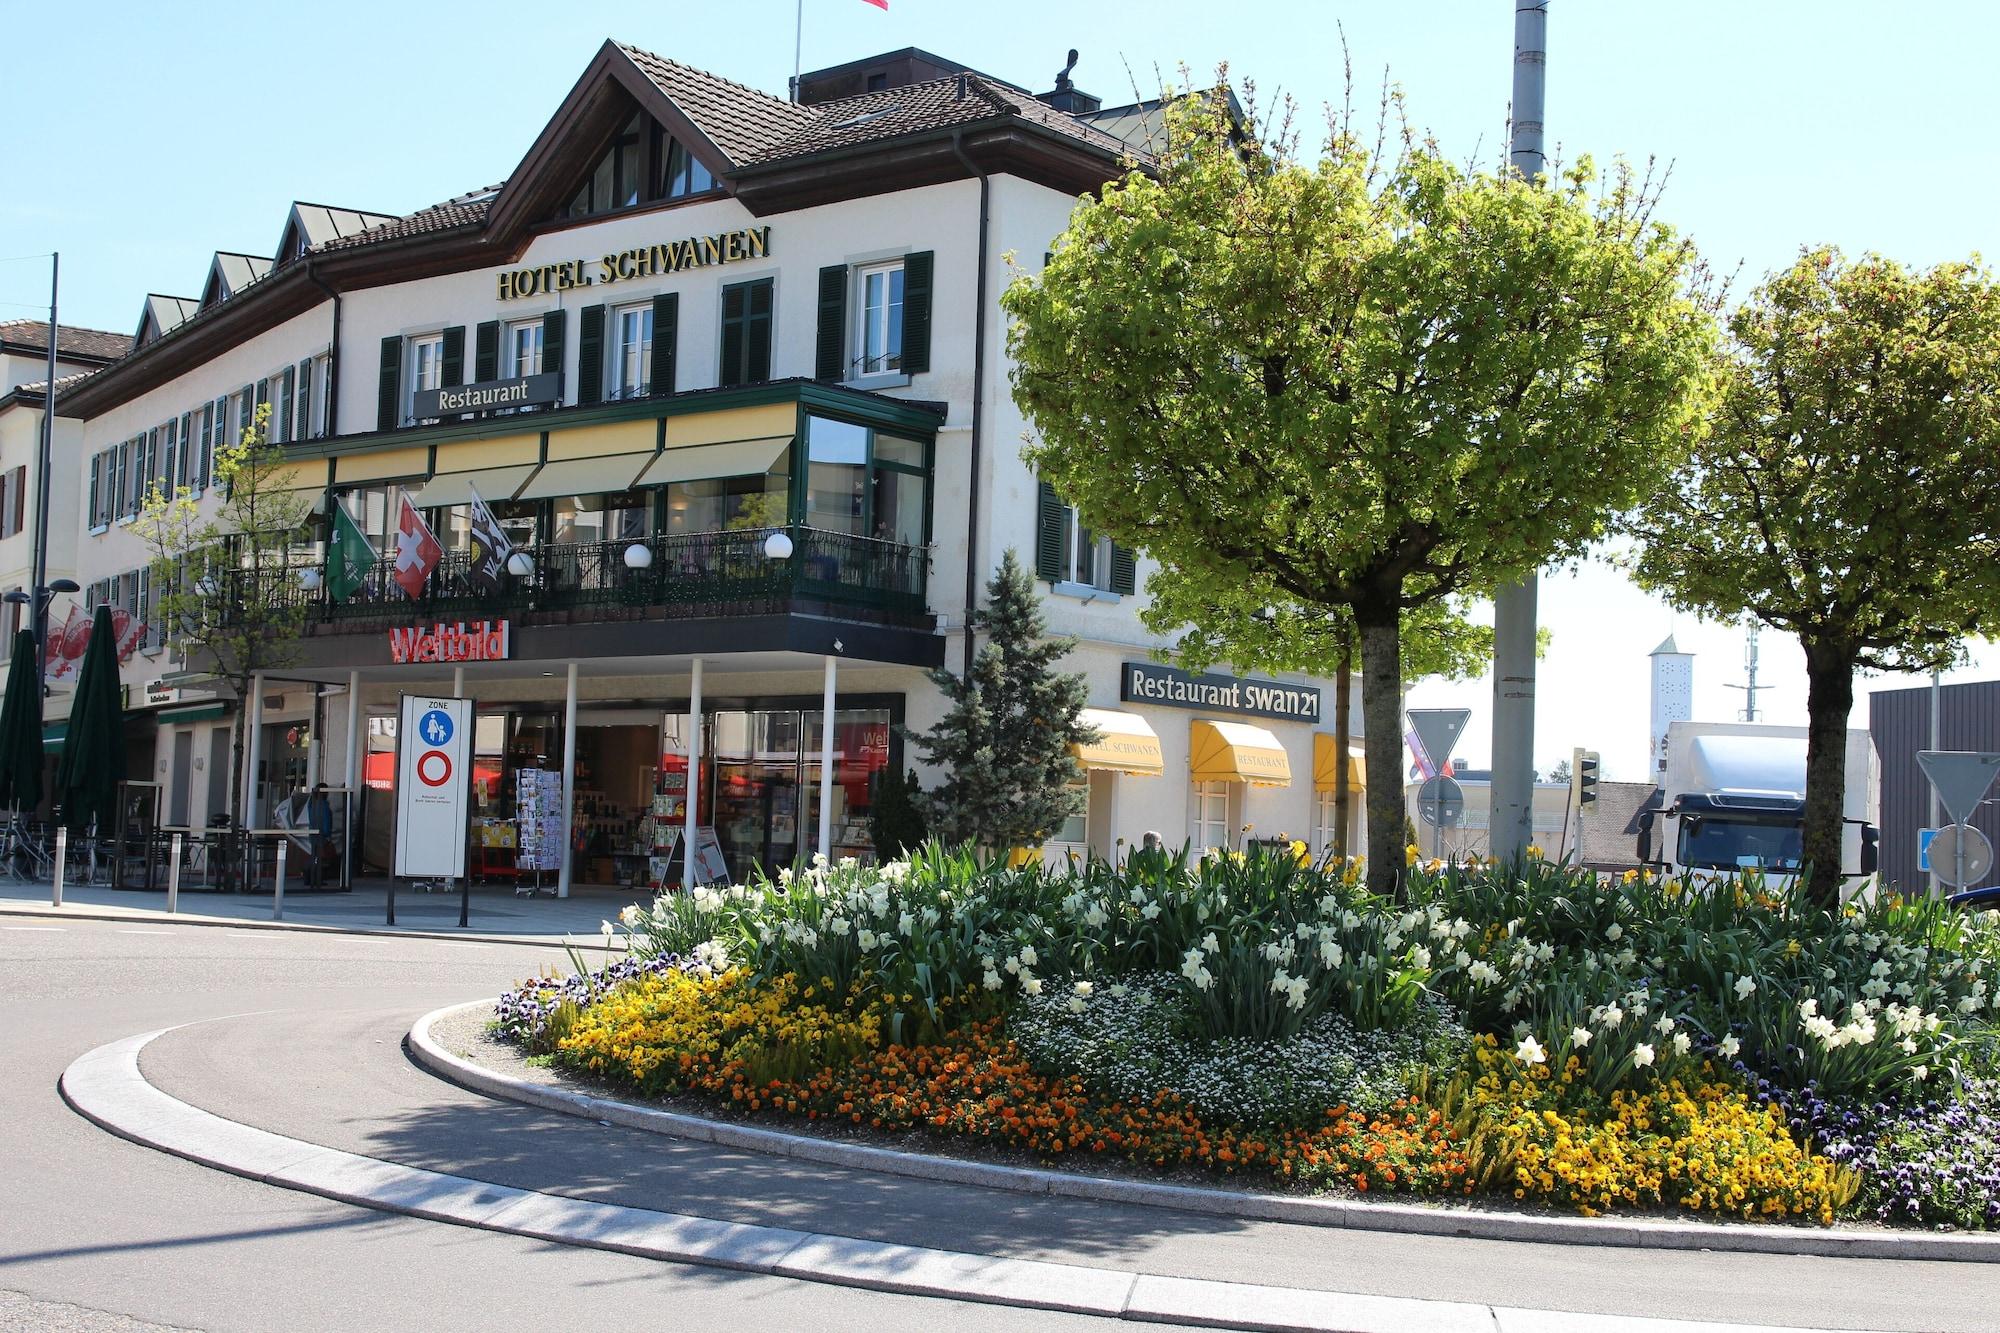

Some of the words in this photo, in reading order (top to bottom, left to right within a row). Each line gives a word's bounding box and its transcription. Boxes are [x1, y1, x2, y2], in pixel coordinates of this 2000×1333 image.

[496, 258, 592, 300] HOTEL
[599, 226, 771, 284] SCHWANEN
[438, 380, 529, 410] Restaurant
[389, 618, 510, 665] Weltbild
[1132, 669, 1240, 708] Restaurant
[428, 701, 449, 710] ZONE
[1113, 742, 1160, 755] SCHWANEN
[1238, 754, 1287, 769] RESTAURANT
